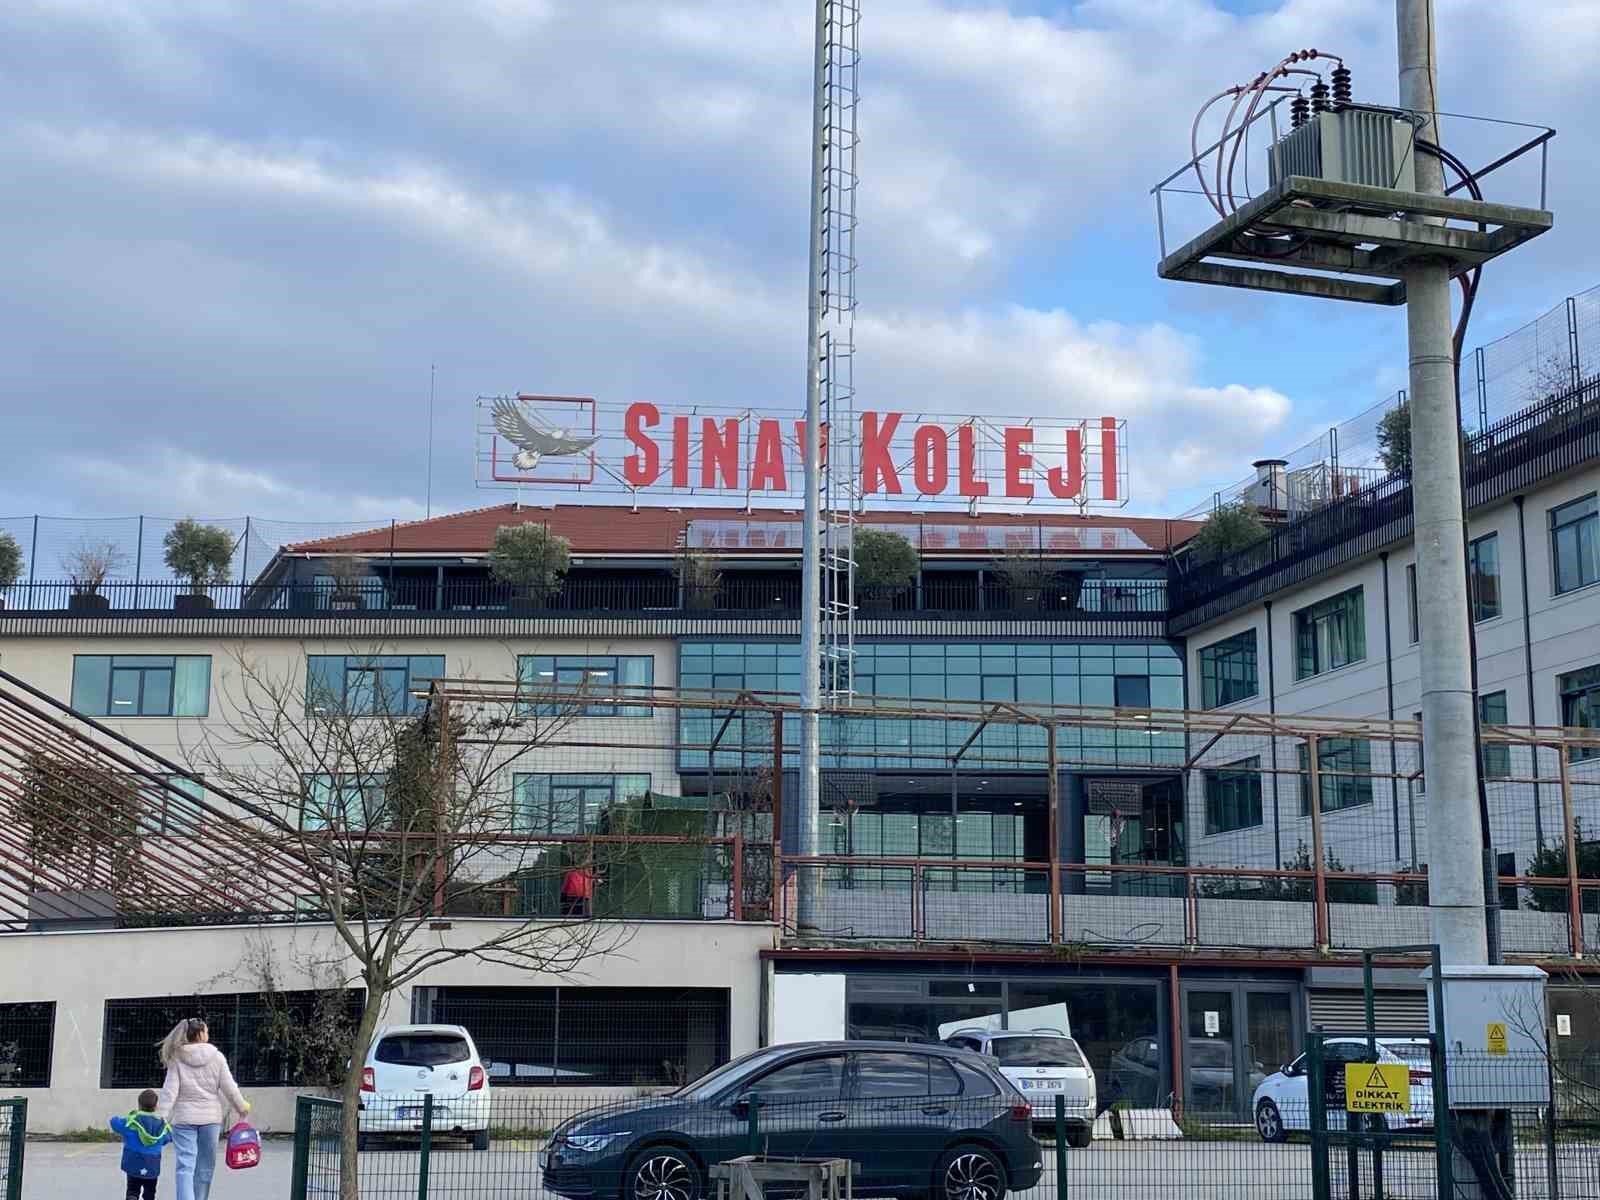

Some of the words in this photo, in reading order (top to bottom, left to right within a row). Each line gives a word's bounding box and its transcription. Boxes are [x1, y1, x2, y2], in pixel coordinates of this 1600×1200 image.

[862, 411, 1117, 500] KOLEJİ
[1355, 1089, 1400, 1100] DİKKAT
[1352, 1100, 1404, 1111] ELEKTRİK
